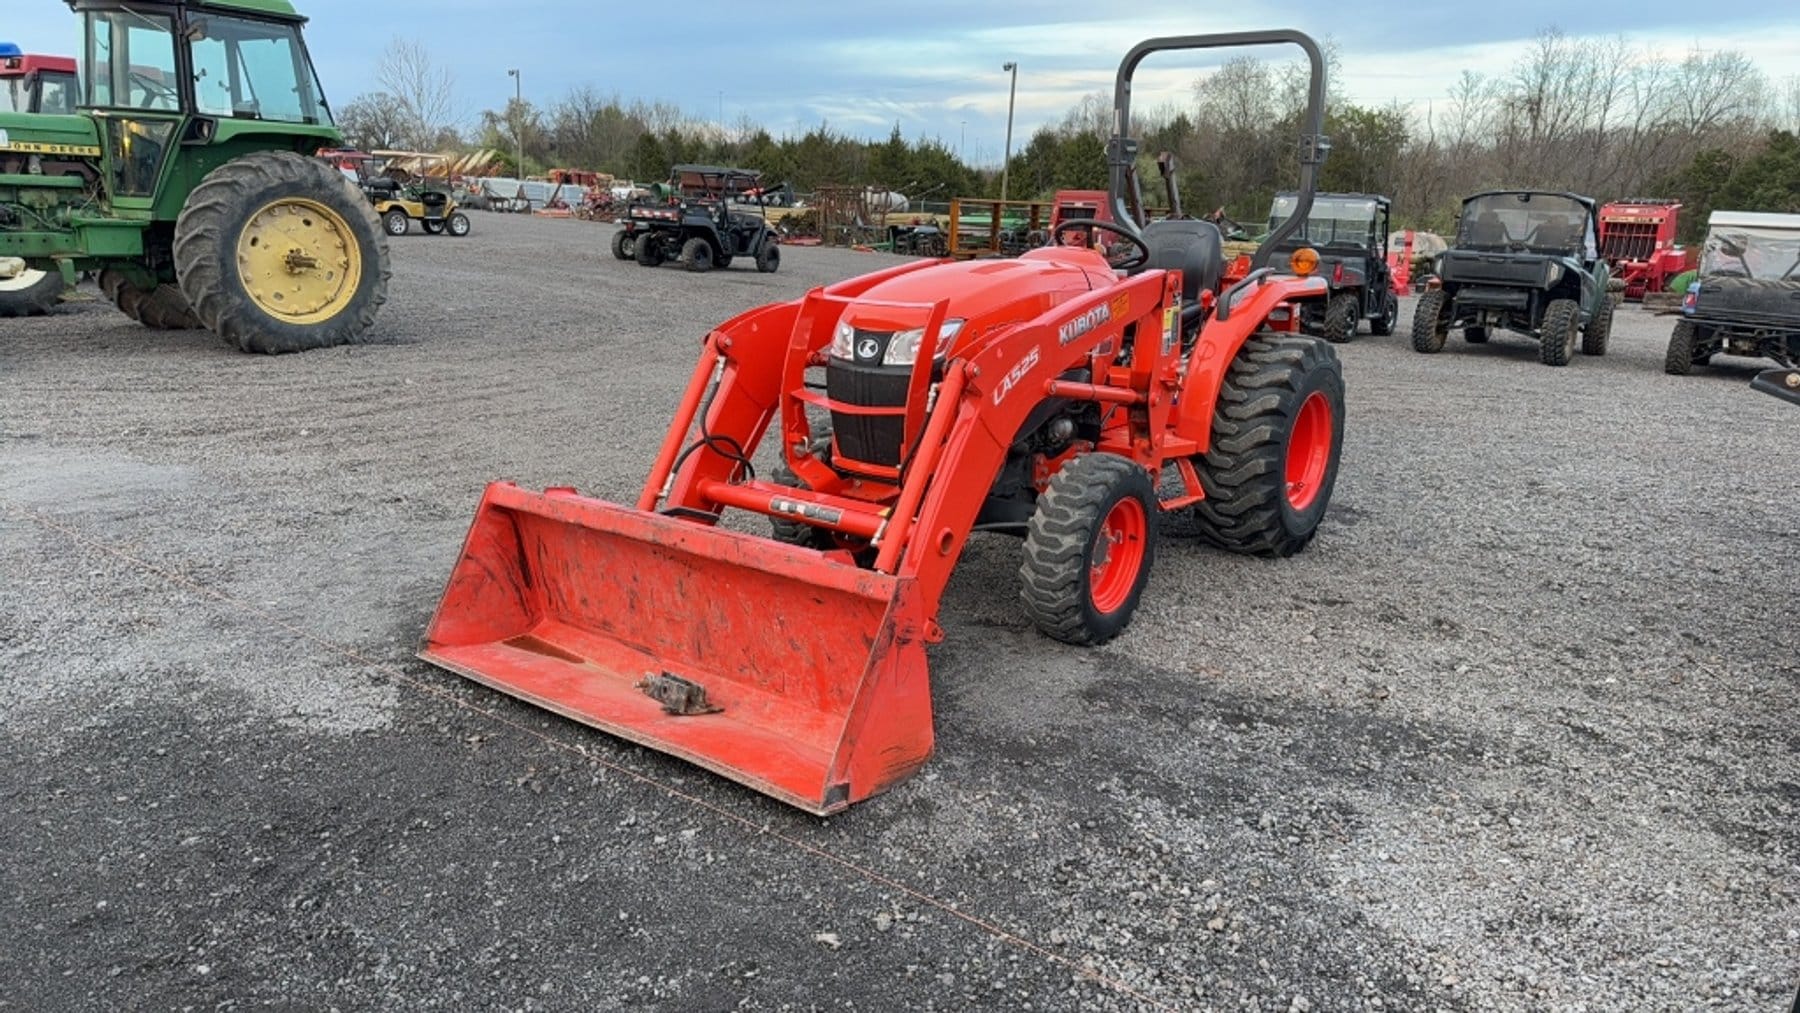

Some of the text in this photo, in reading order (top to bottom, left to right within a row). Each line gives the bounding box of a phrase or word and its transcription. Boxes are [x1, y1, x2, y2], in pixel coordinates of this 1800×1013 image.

[50, 145, 93, 154] DEERE
[1059, 301, 1111, 346] KUBOTA
[992, 345, 1040, 405] LA525
